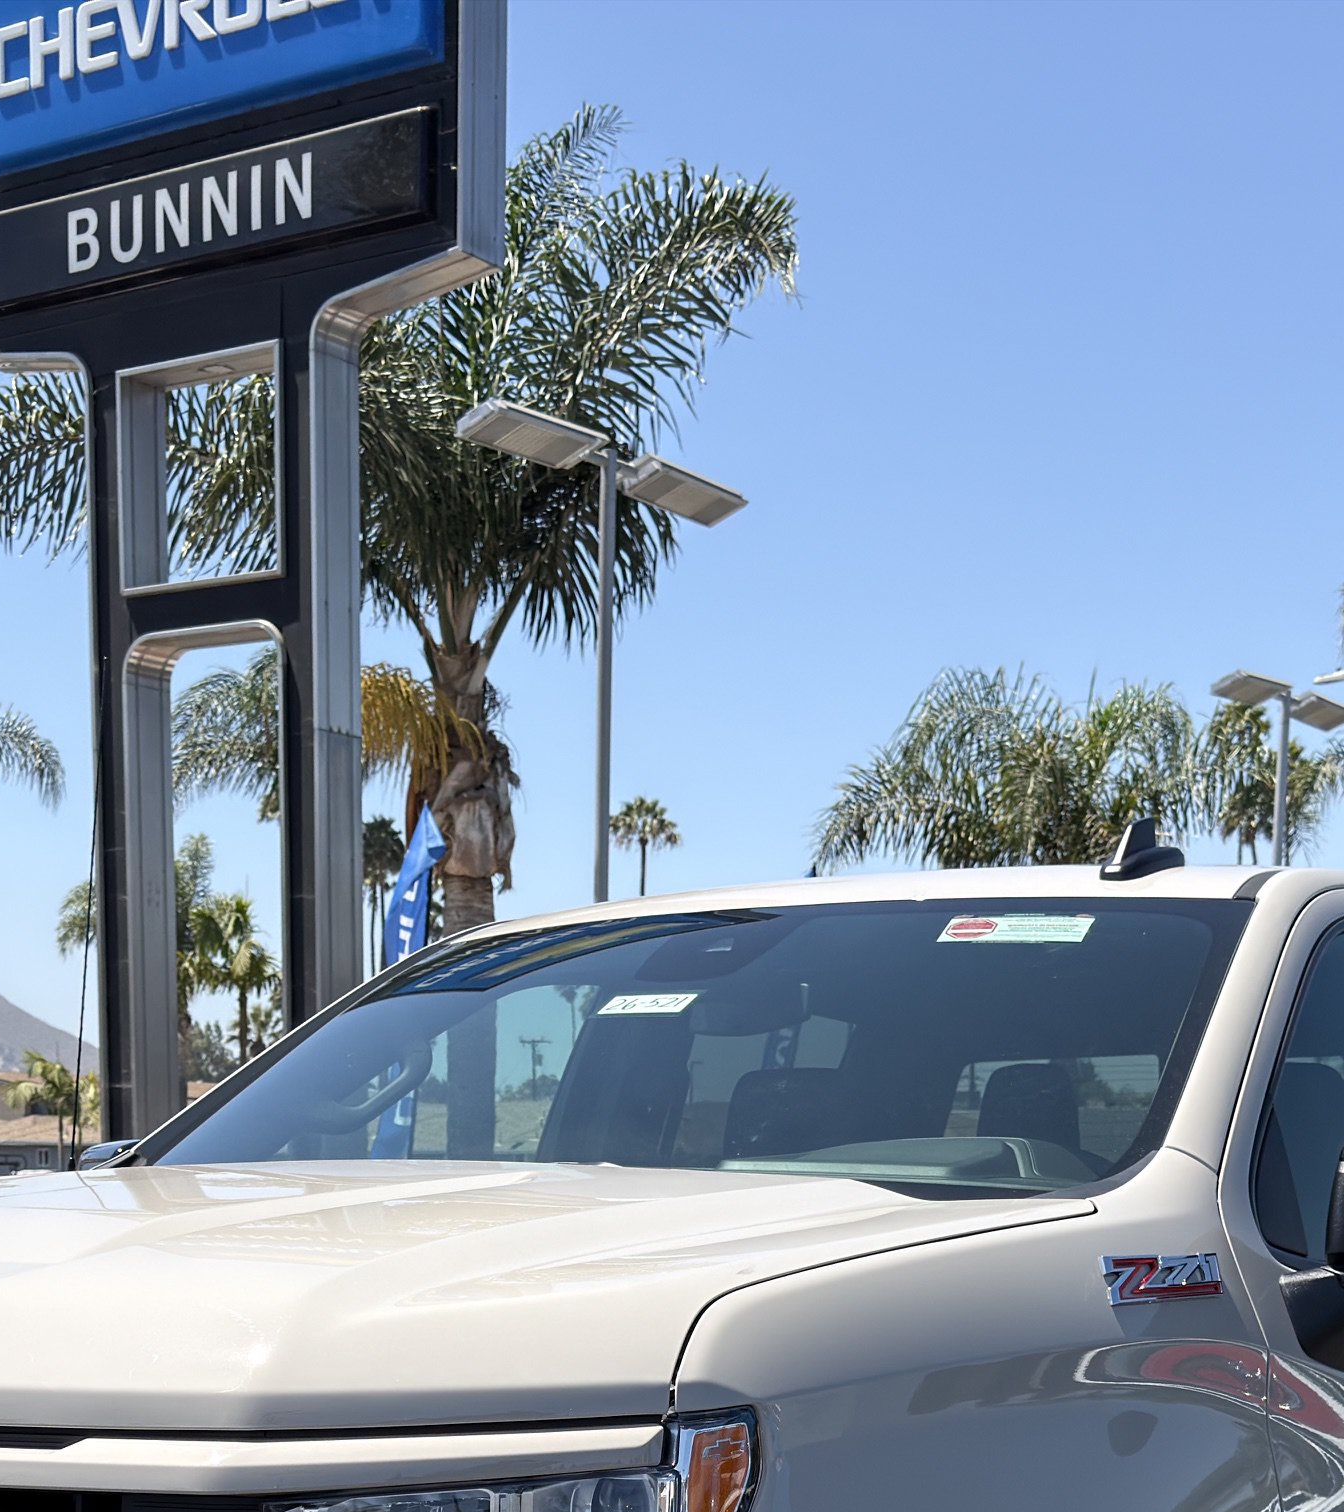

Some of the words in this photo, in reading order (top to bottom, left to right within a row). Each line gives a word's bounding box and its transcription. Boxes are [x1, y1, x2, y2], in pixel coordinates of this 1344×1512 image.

[67, 152, 313, 275] BUNNIN
[605, 996, 689, 1011] 26-521
[1098, 1252, 1223, 1306] Z71
